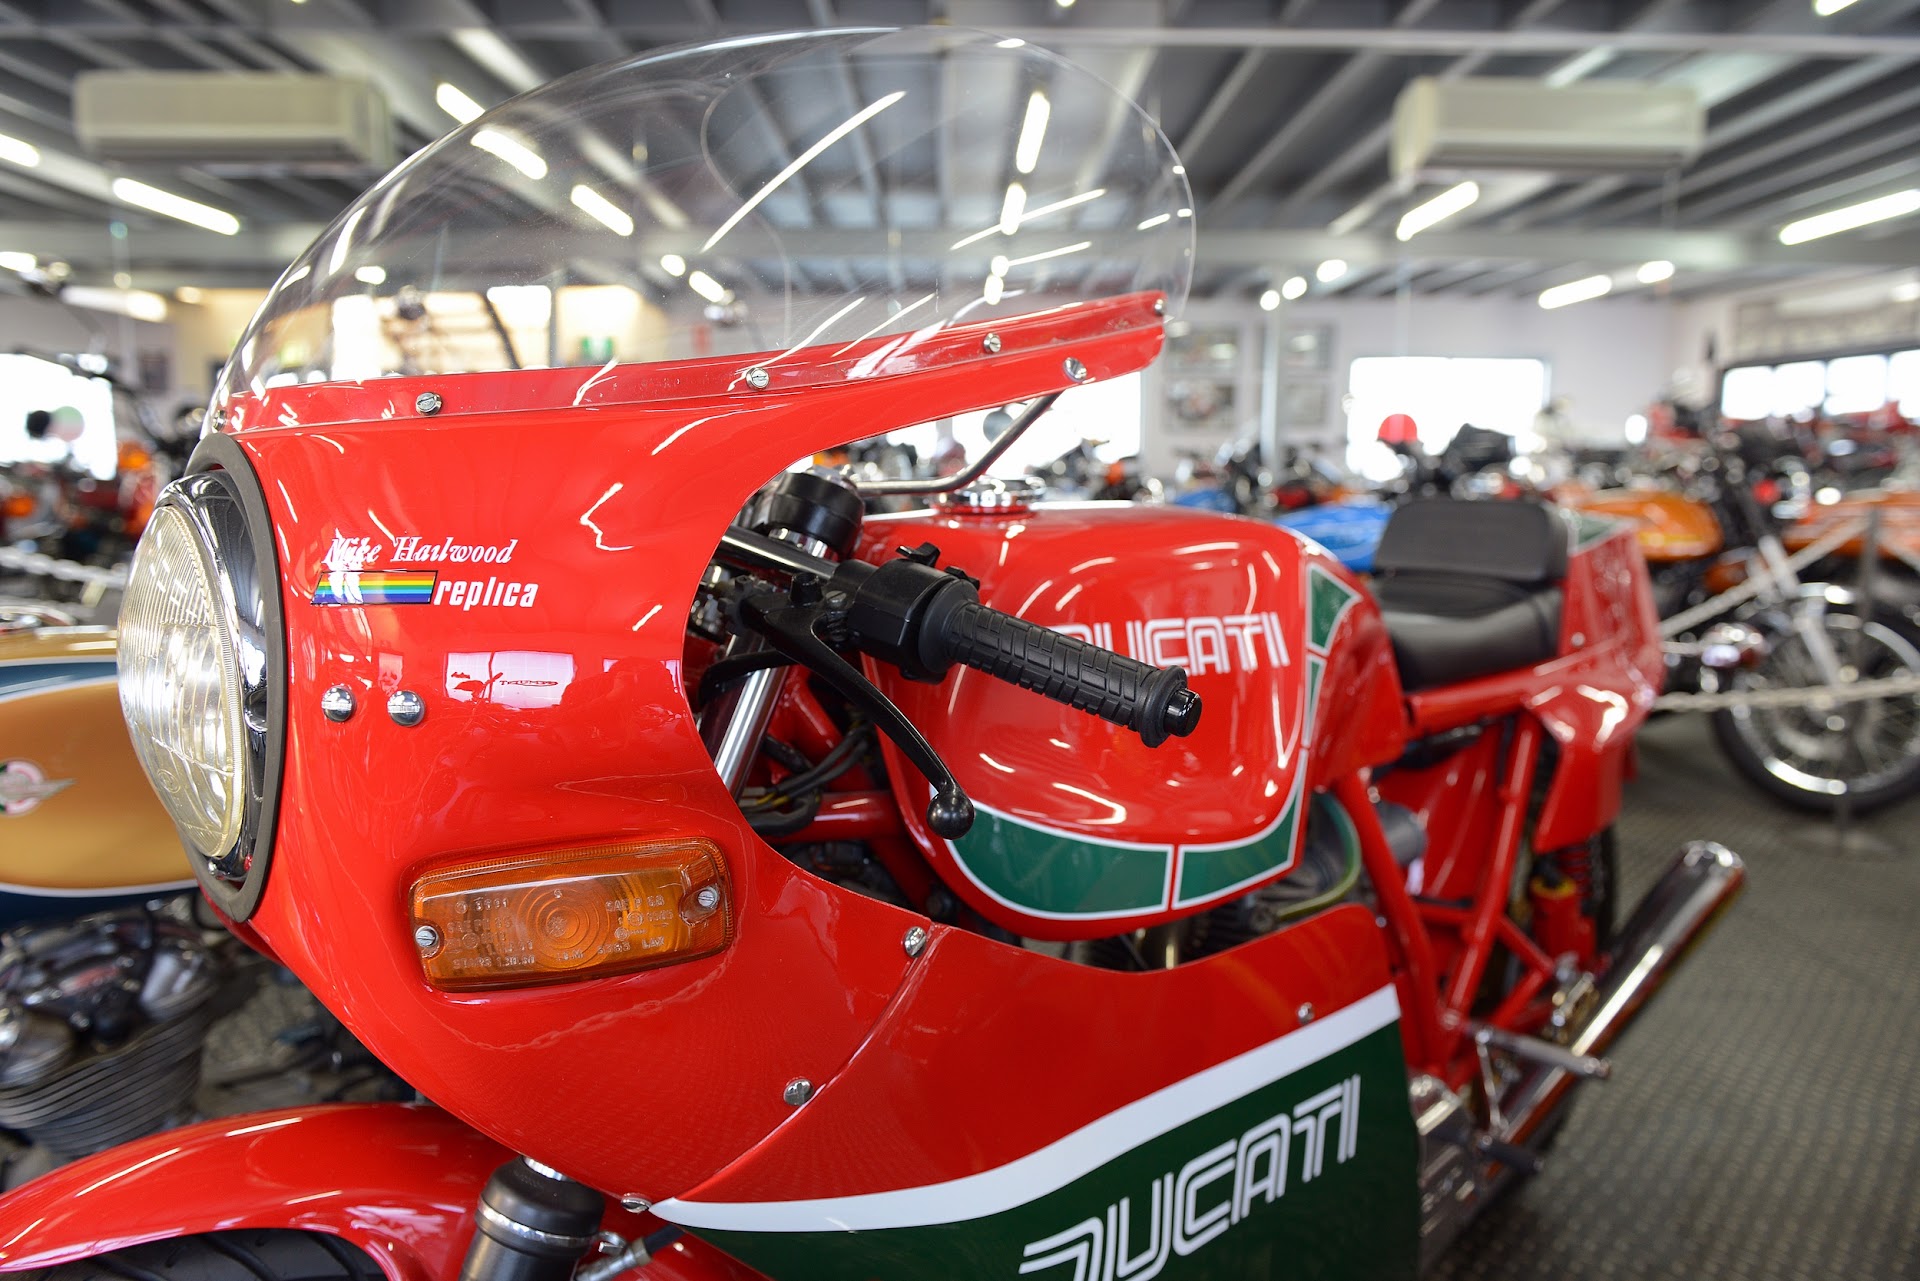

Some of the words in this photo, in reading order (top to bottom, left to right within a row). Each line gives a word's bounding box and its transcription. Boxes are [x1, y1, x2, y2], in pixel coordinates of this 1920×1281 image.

[321, 537, 382, 566] Mike
[390, 536, 518, 563] Hailwood
[434, 577, 539, 611] replica
[1048, 612, 1291, 677] UCATI
